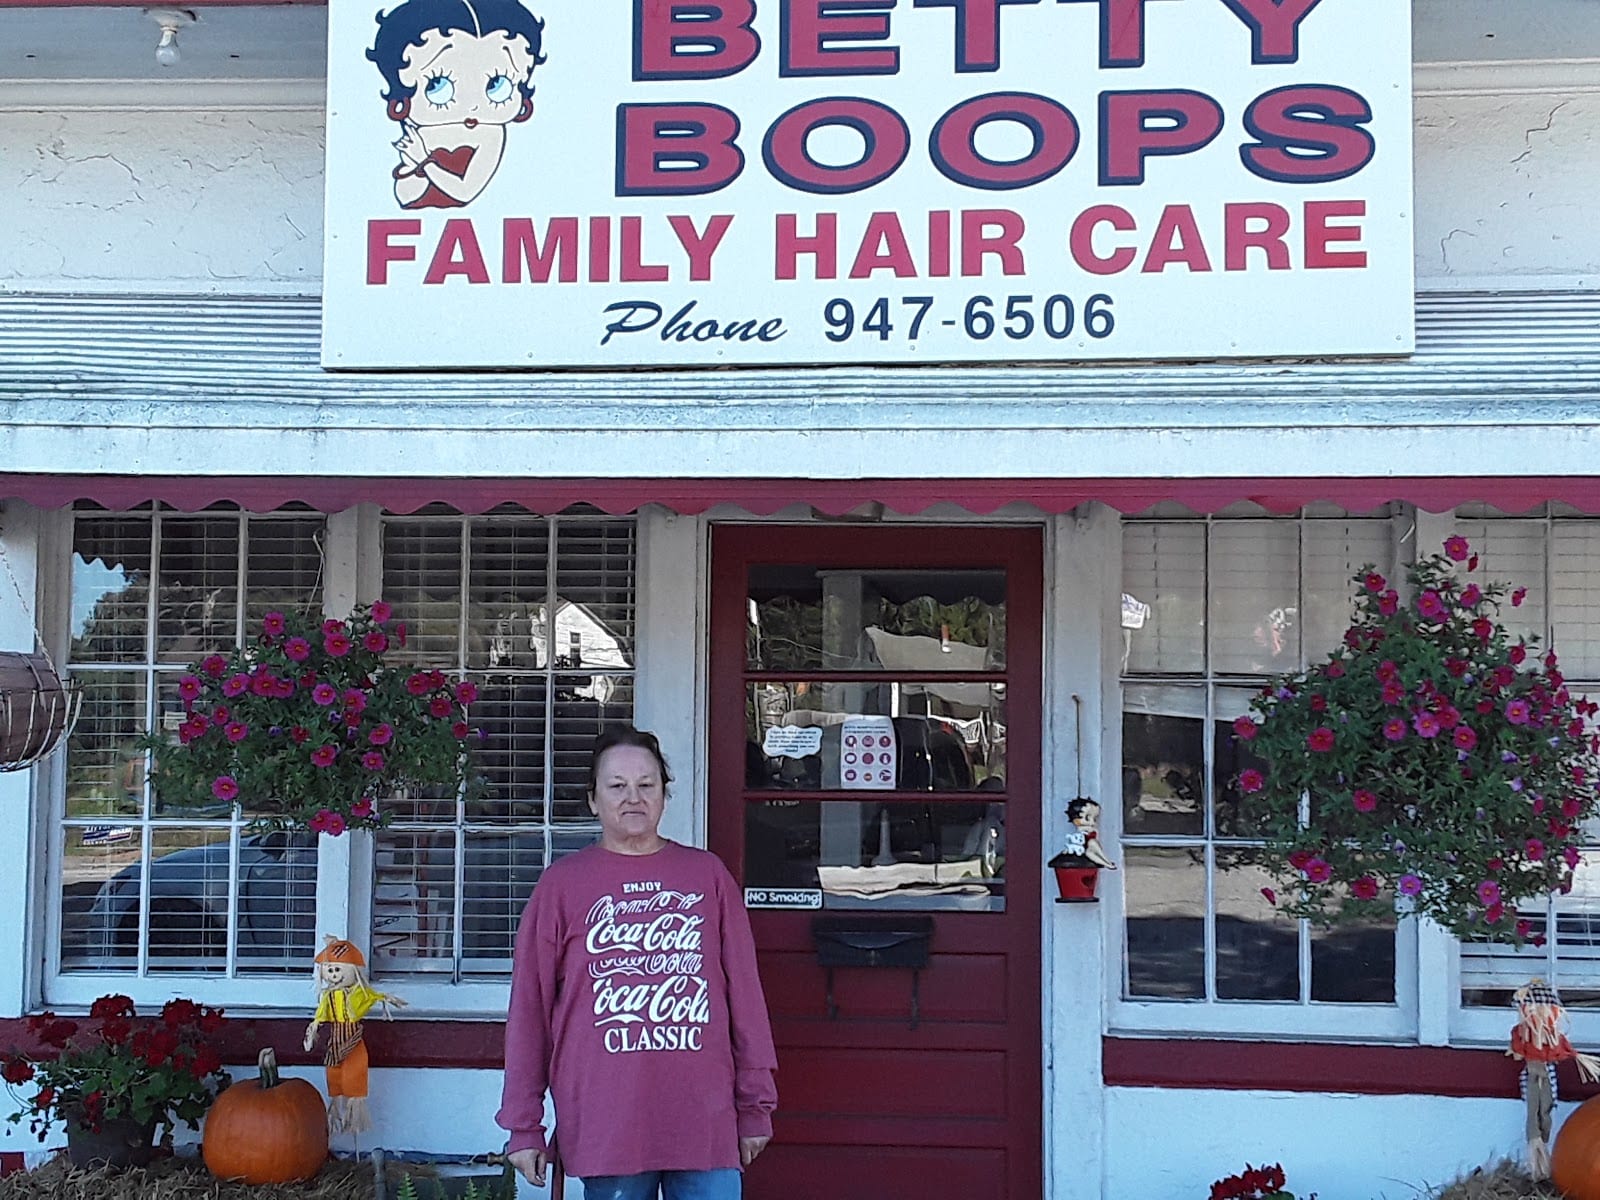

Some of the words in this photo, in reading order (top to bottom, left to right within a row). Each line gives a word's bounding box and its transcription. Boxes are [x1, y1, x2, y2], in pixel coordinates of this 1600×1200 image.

[633, 0, 1323, 82] BETTY
[615, 84, 1376, 196] BOOPS
[366, 216, 735, 286] FAMILY
[774, 209, 1026, 281] HAIR
[1069, 200, 1368, 276] CARE
[601, 300, 788, 346] Phone
[824, 296, 1116, 341] 947-6506
[623, 881, 661, 893] ENJOY
[748, 892, 767, 902] NO
[769, 892, 819, 907] Smoking
[593, 976, 709, 1026] oca-Col
[604, 1026, 702, 1053] CLASSIC
